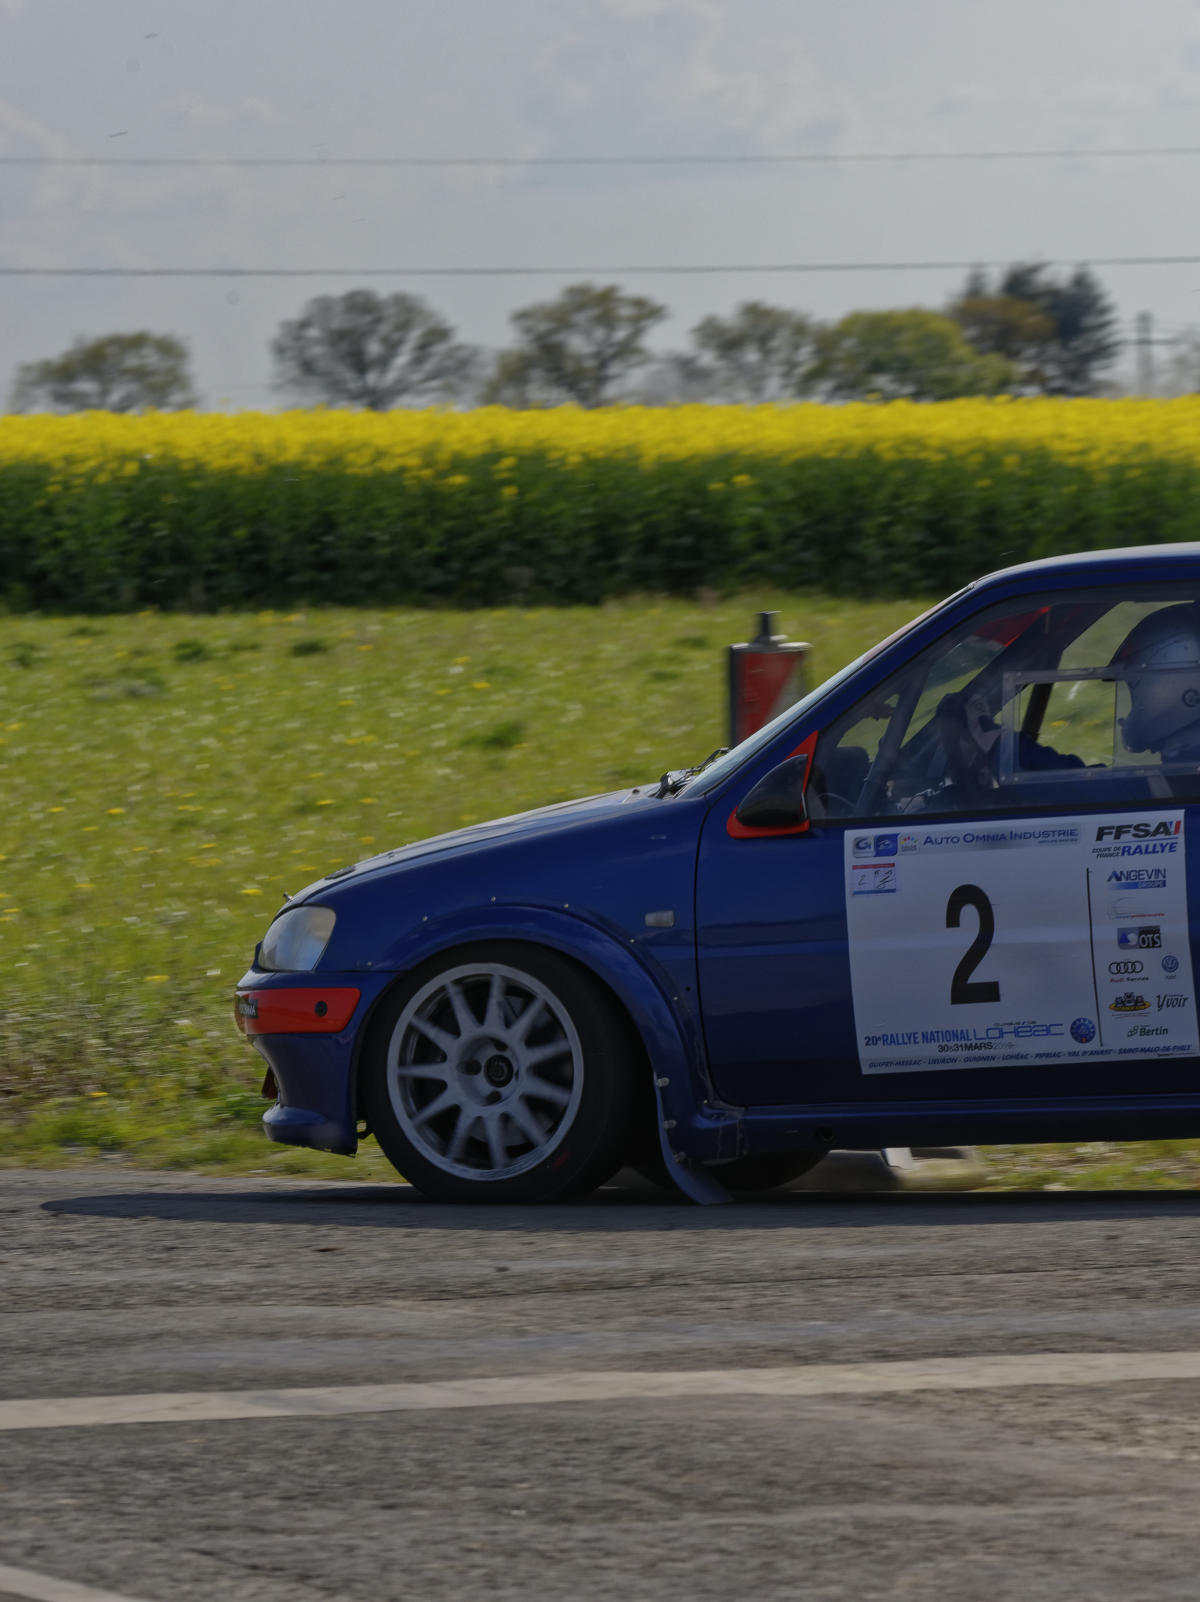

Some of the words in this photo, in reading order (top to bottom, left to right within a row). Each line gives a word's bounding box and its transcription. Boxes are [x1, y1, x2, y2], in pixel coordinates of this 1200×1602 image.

[963, 832, 1007, 844] OMNIA
[1009, 828, 1079, 841] INDUSTRIE
[1095, 821, 1172, 842] FFSA
[1121, 842, 1178, 857] RALLYE
[1107, 868, 1166, 882] ANGEVIN
[945, 883, 1001, 1006] 2
[882, 1031, 919, 1046] RALLYE
[921, 1029, 973, 1044] NATIONAL
[1140, 1025, 1168, 1037] Bertin
